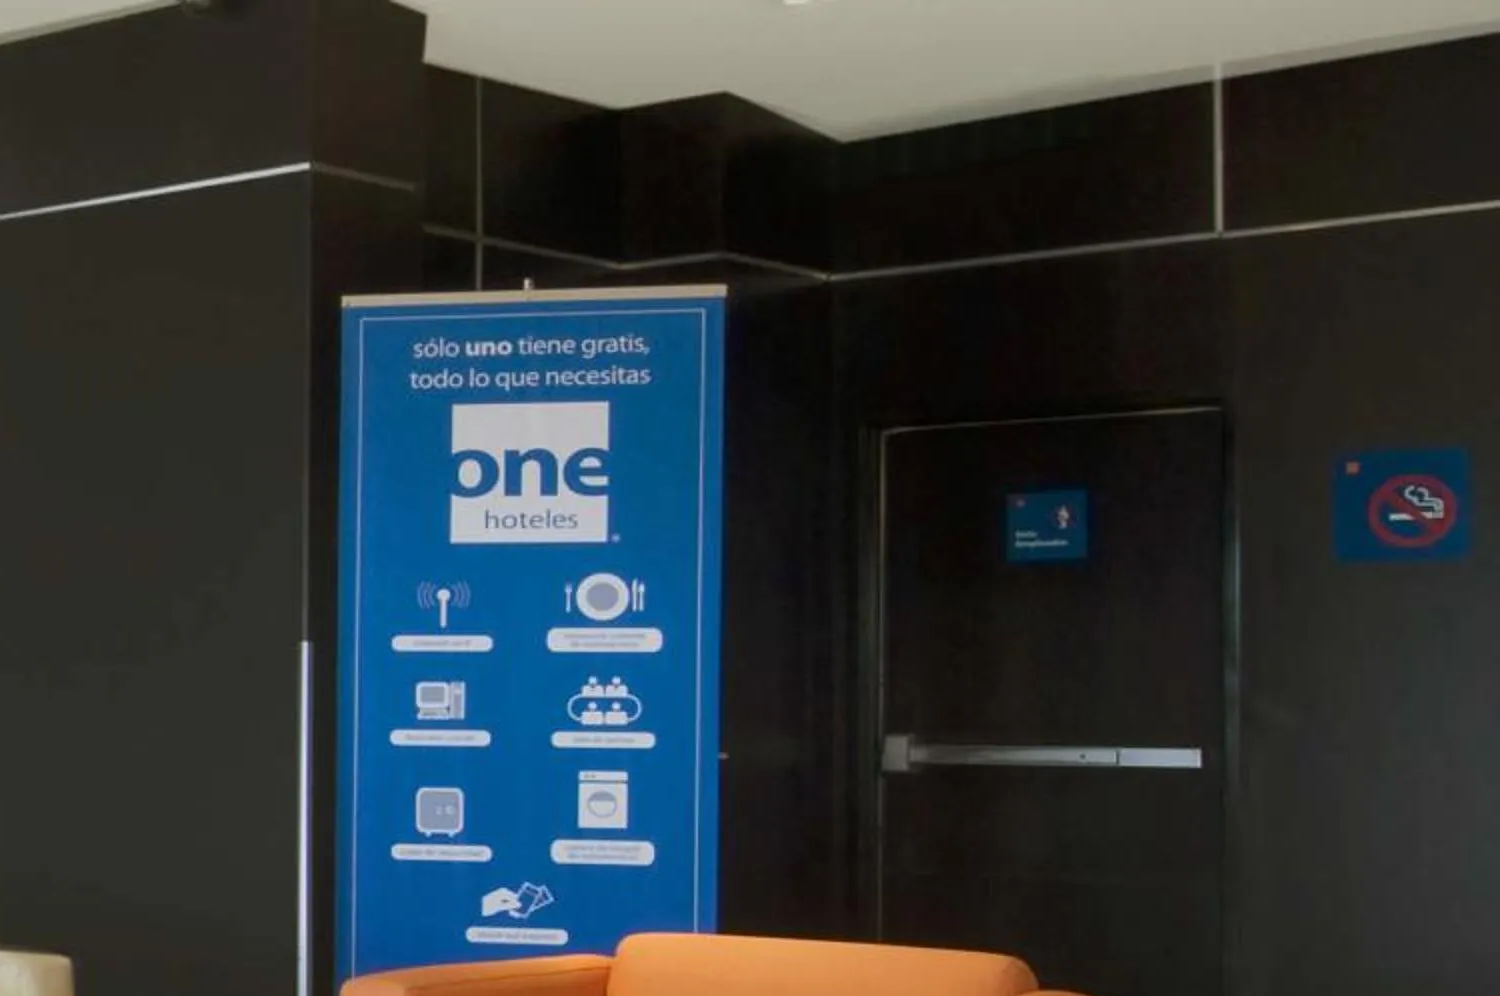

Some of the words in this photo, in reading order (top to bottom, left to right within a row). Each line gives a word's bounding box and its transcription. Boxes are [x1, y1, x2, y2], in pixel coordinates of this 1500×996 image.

[413, 336, 460, 359] sólo
[465, 340, 513, 356] uno
[517, 335, 576, 355] tiene
[580, 333, 650, 359] gratis,
[410, 368, 463, 389] todo
[469, 368, 490, 388] lo
[495, 371, 540, 392] que
[545, 364, 652, 386] necesitas
[451, 446, 610, 498] one
[484, 509, 579, 530] hoteles
